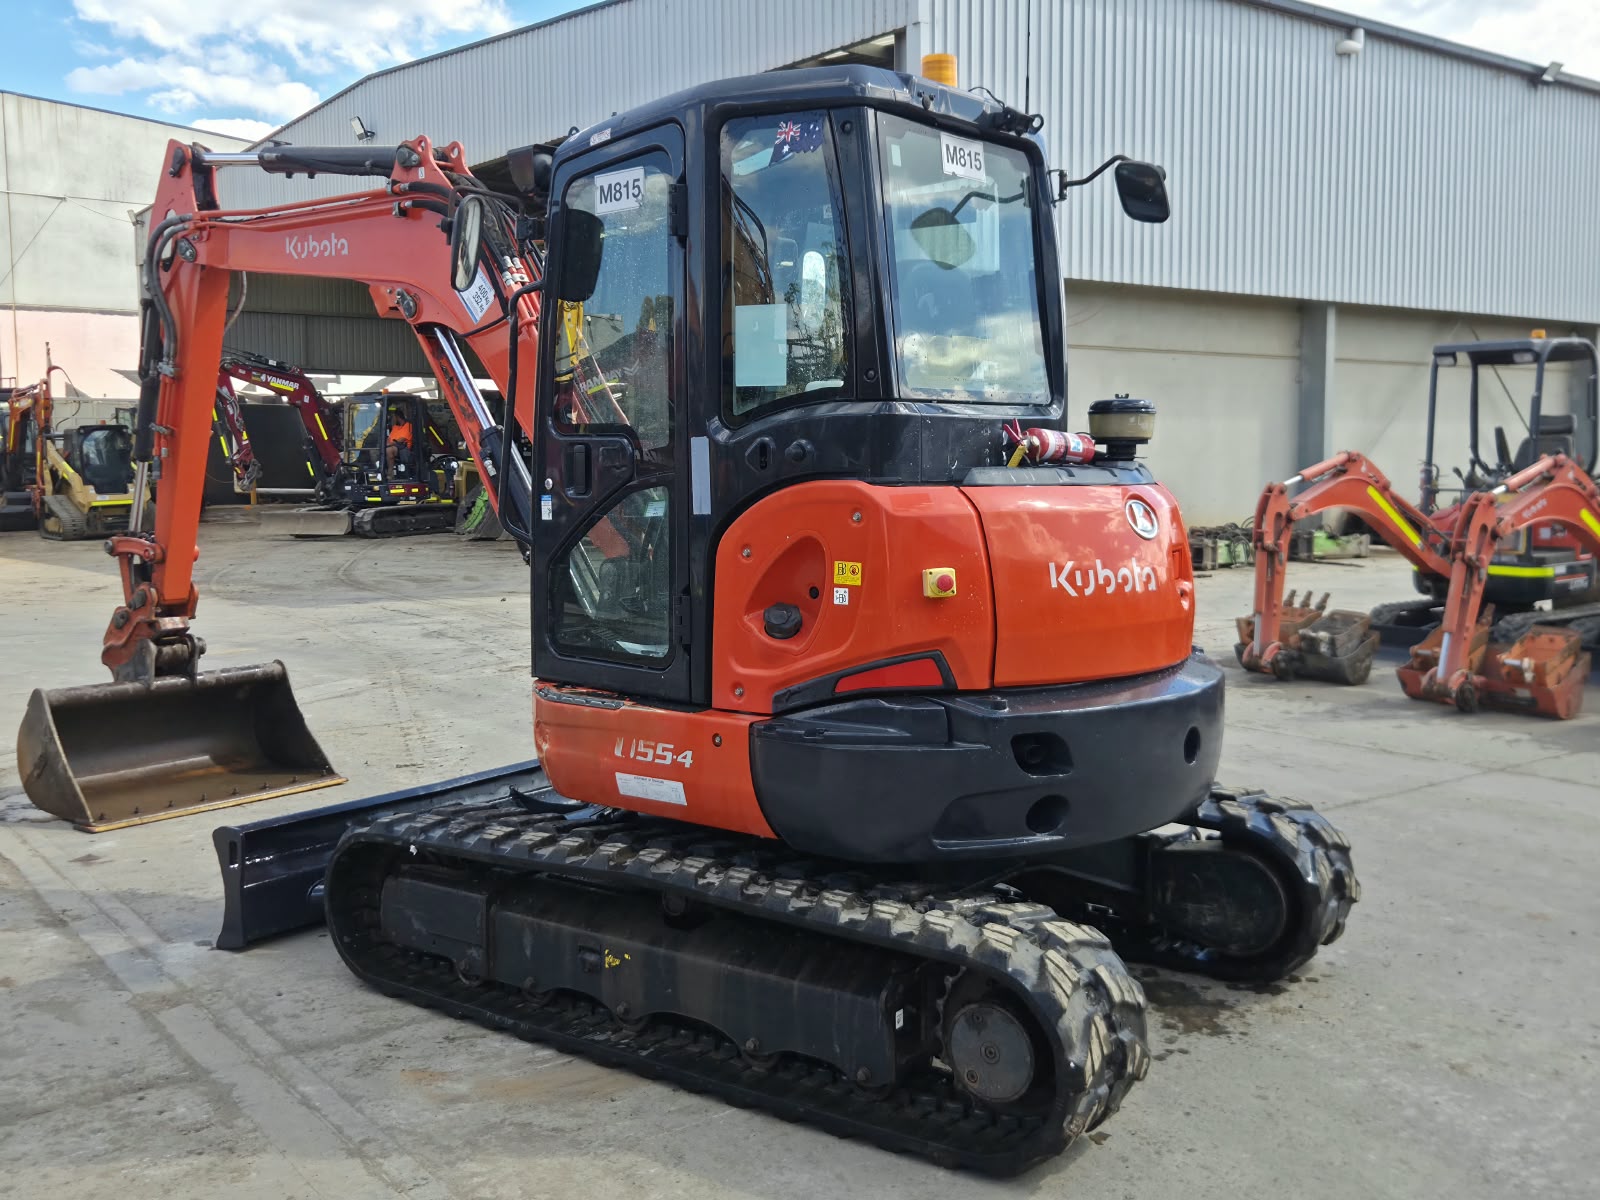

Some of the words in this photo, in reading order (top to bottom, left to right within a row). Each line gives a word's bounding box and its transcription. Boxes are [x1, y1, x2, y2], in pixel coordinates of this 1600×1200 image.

[946, 144, 982, 171] M815
[600, 178, 641, 205] M815
[285, 232, 349, 259] Kubota
[267, 374, 299, 390] YANMAR
[1049, 557, 1157, 597] Kubota
